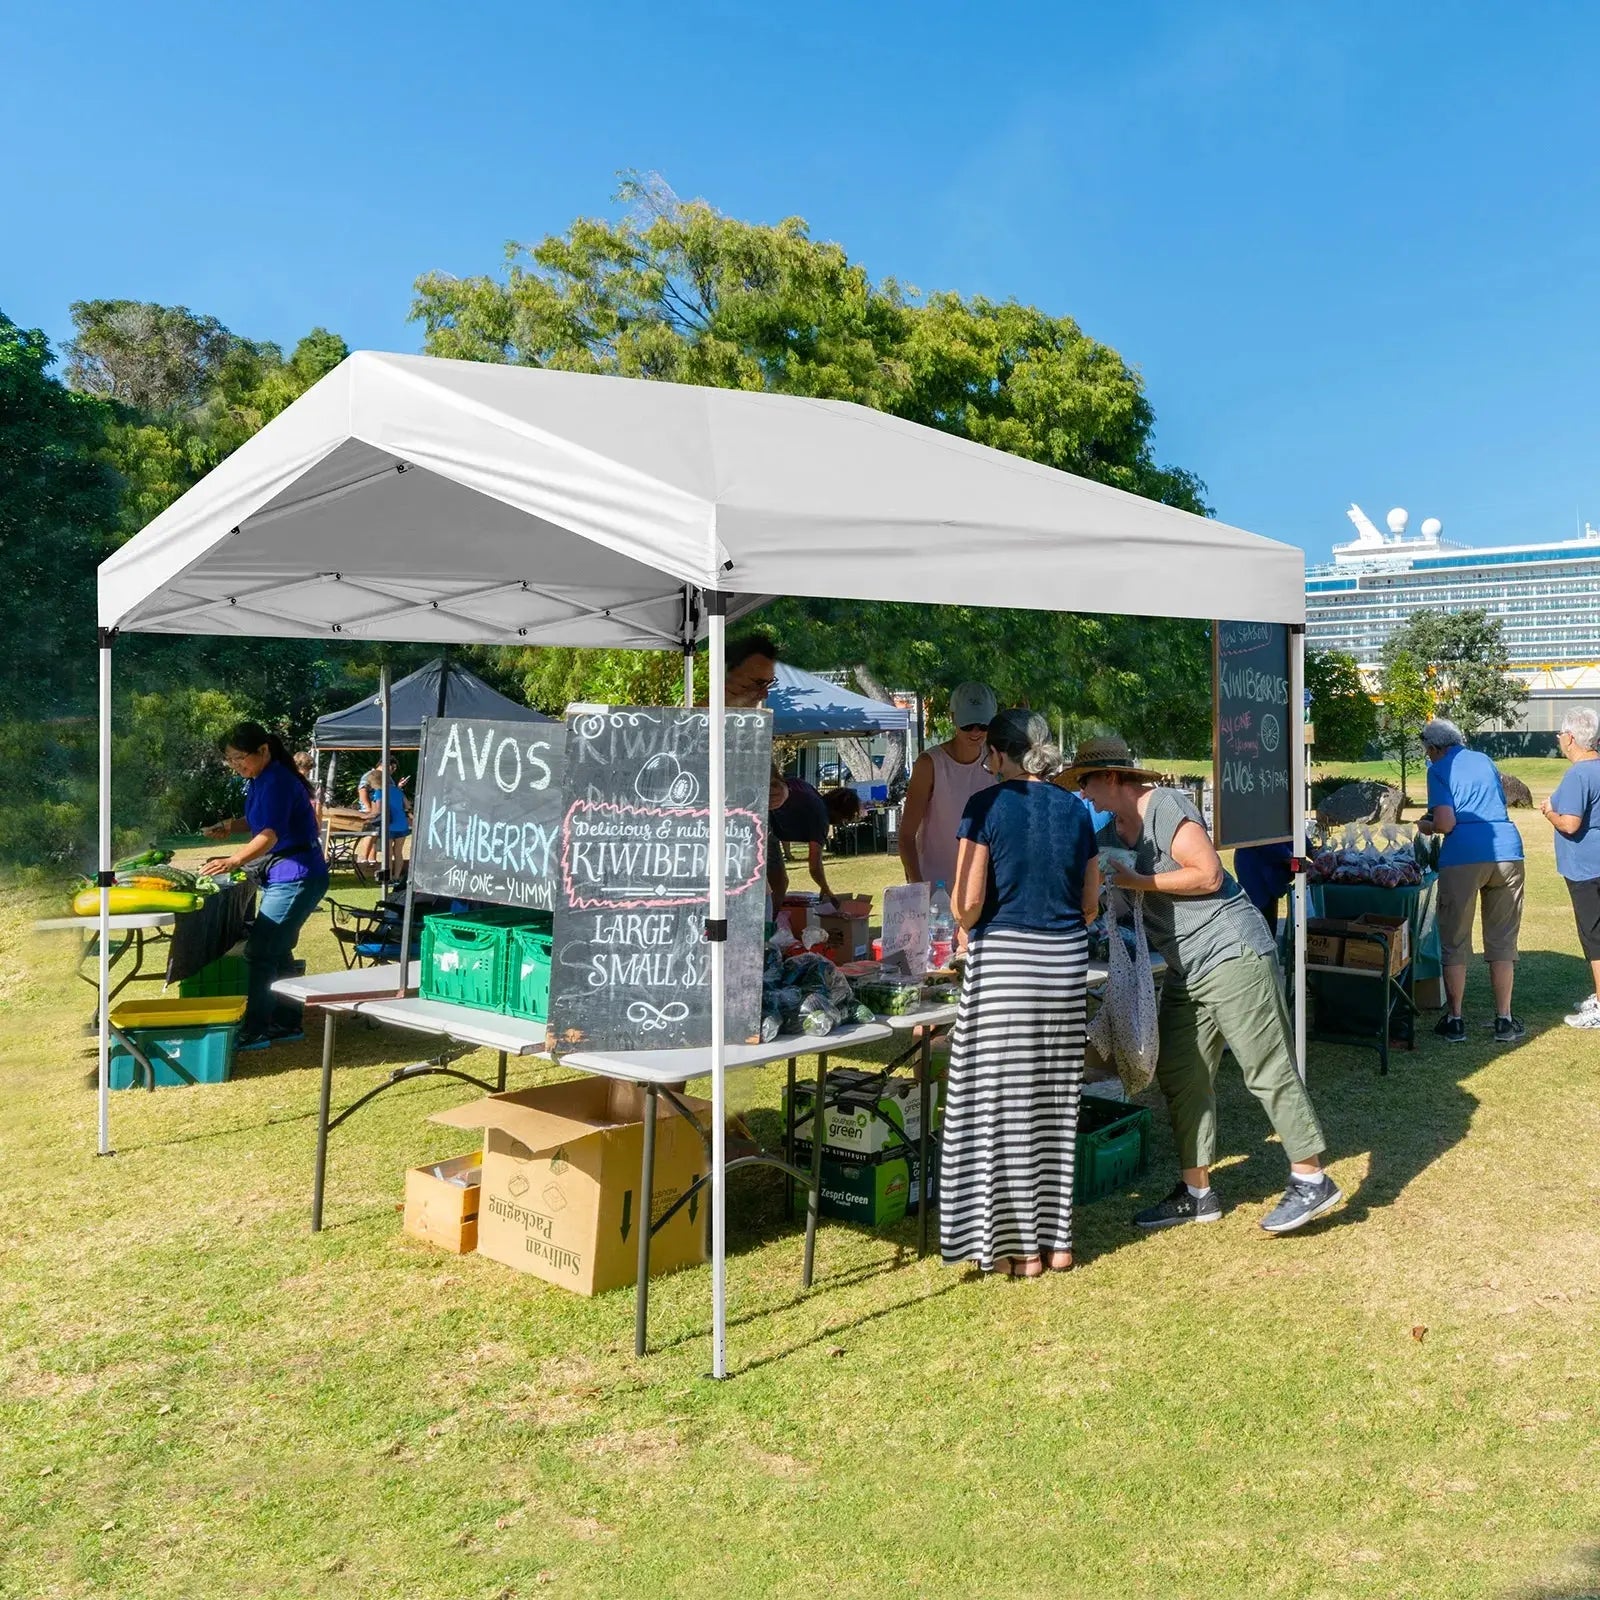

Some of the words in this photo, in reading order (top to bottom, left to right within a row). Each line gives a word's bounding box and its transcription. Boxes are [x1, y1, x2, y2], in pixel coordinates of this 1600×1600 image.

[438, 723, 551, 793] AVOS
[428, 796, 559, 878] KIWIBERRY
[573, 815, 653, 840] Delicious
[656, 819, 672, 839] &
[443, 864, 469, 893] TRY
[590, 914, 675, 948] LARGE
[588, 953, 678, 987] SMALL
[829, 1124, 863, 1139] green
[821, 1188, 845, 1201] Zespri
[845, 1192, 869, 1205] Green
[489, 1195, 553, 1240] Packaging
[526, 1239, 580, 1276] Sullivan
